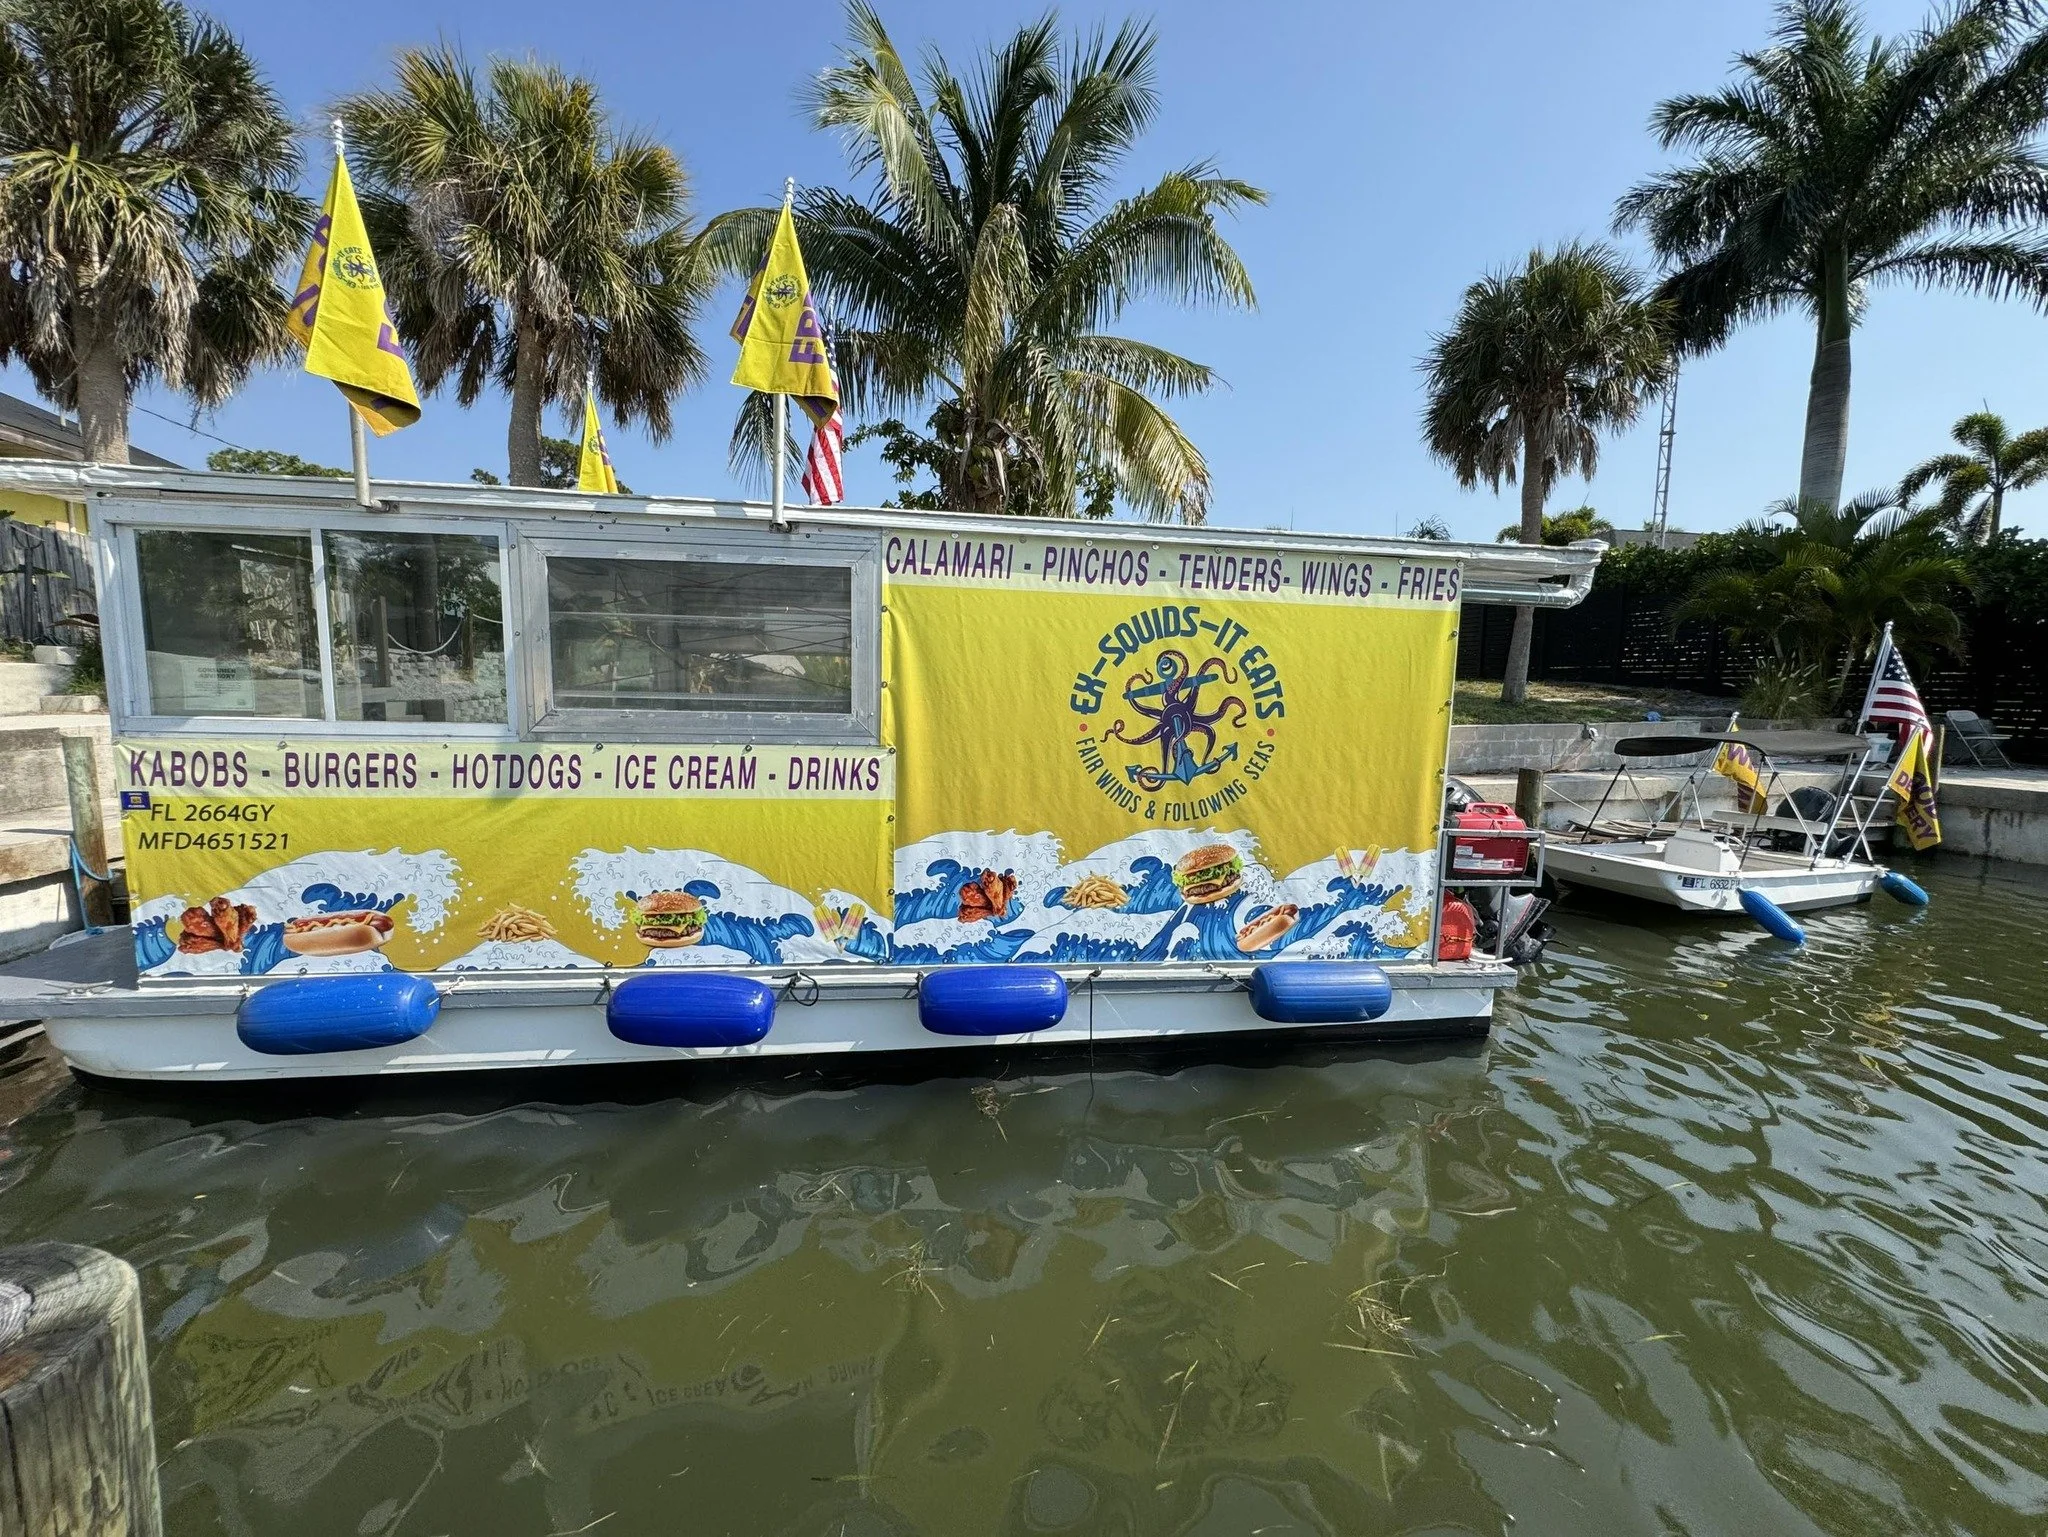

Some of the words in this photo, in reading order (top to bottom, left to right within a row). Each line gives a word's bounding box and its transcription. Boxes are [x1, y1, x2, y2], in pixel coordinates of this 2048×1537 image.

[885, 536, 1014, 580] CALAMARI
[1042, 546, 1150, 587] PINCHOS
[1301, 560, 1373, 598] WINGS
[1397, 566, 1460, 603] FRIES
[1070, 605, 1250, 715] EX-SQUIDS-IT
[1238, 645, 1285, 720] EATS
[130, 750, 249, 788] KABOBS
[284, 752, 418, 789] BURGERS
[452, 753, 582, 790] HOTDOGS
[615, 755, 657, 790] ICE
[668, 755, 757, 790] CREAM
[788, 757, 880, 791] DRINKS
[1076, 736, 1104, 775] FAIR
[1095, 766, 1142, 815] WINDS
[1144, 800, 1156, 820] &
[1163, 778, 1248, 822] FOLLOWING
[1243, 740, 1276, 781] SEAS
[150, 803, 177, 822] FL
[183, 803, 276, 822] 2664GY
[138, 832, 290, 851] MFD4651521
